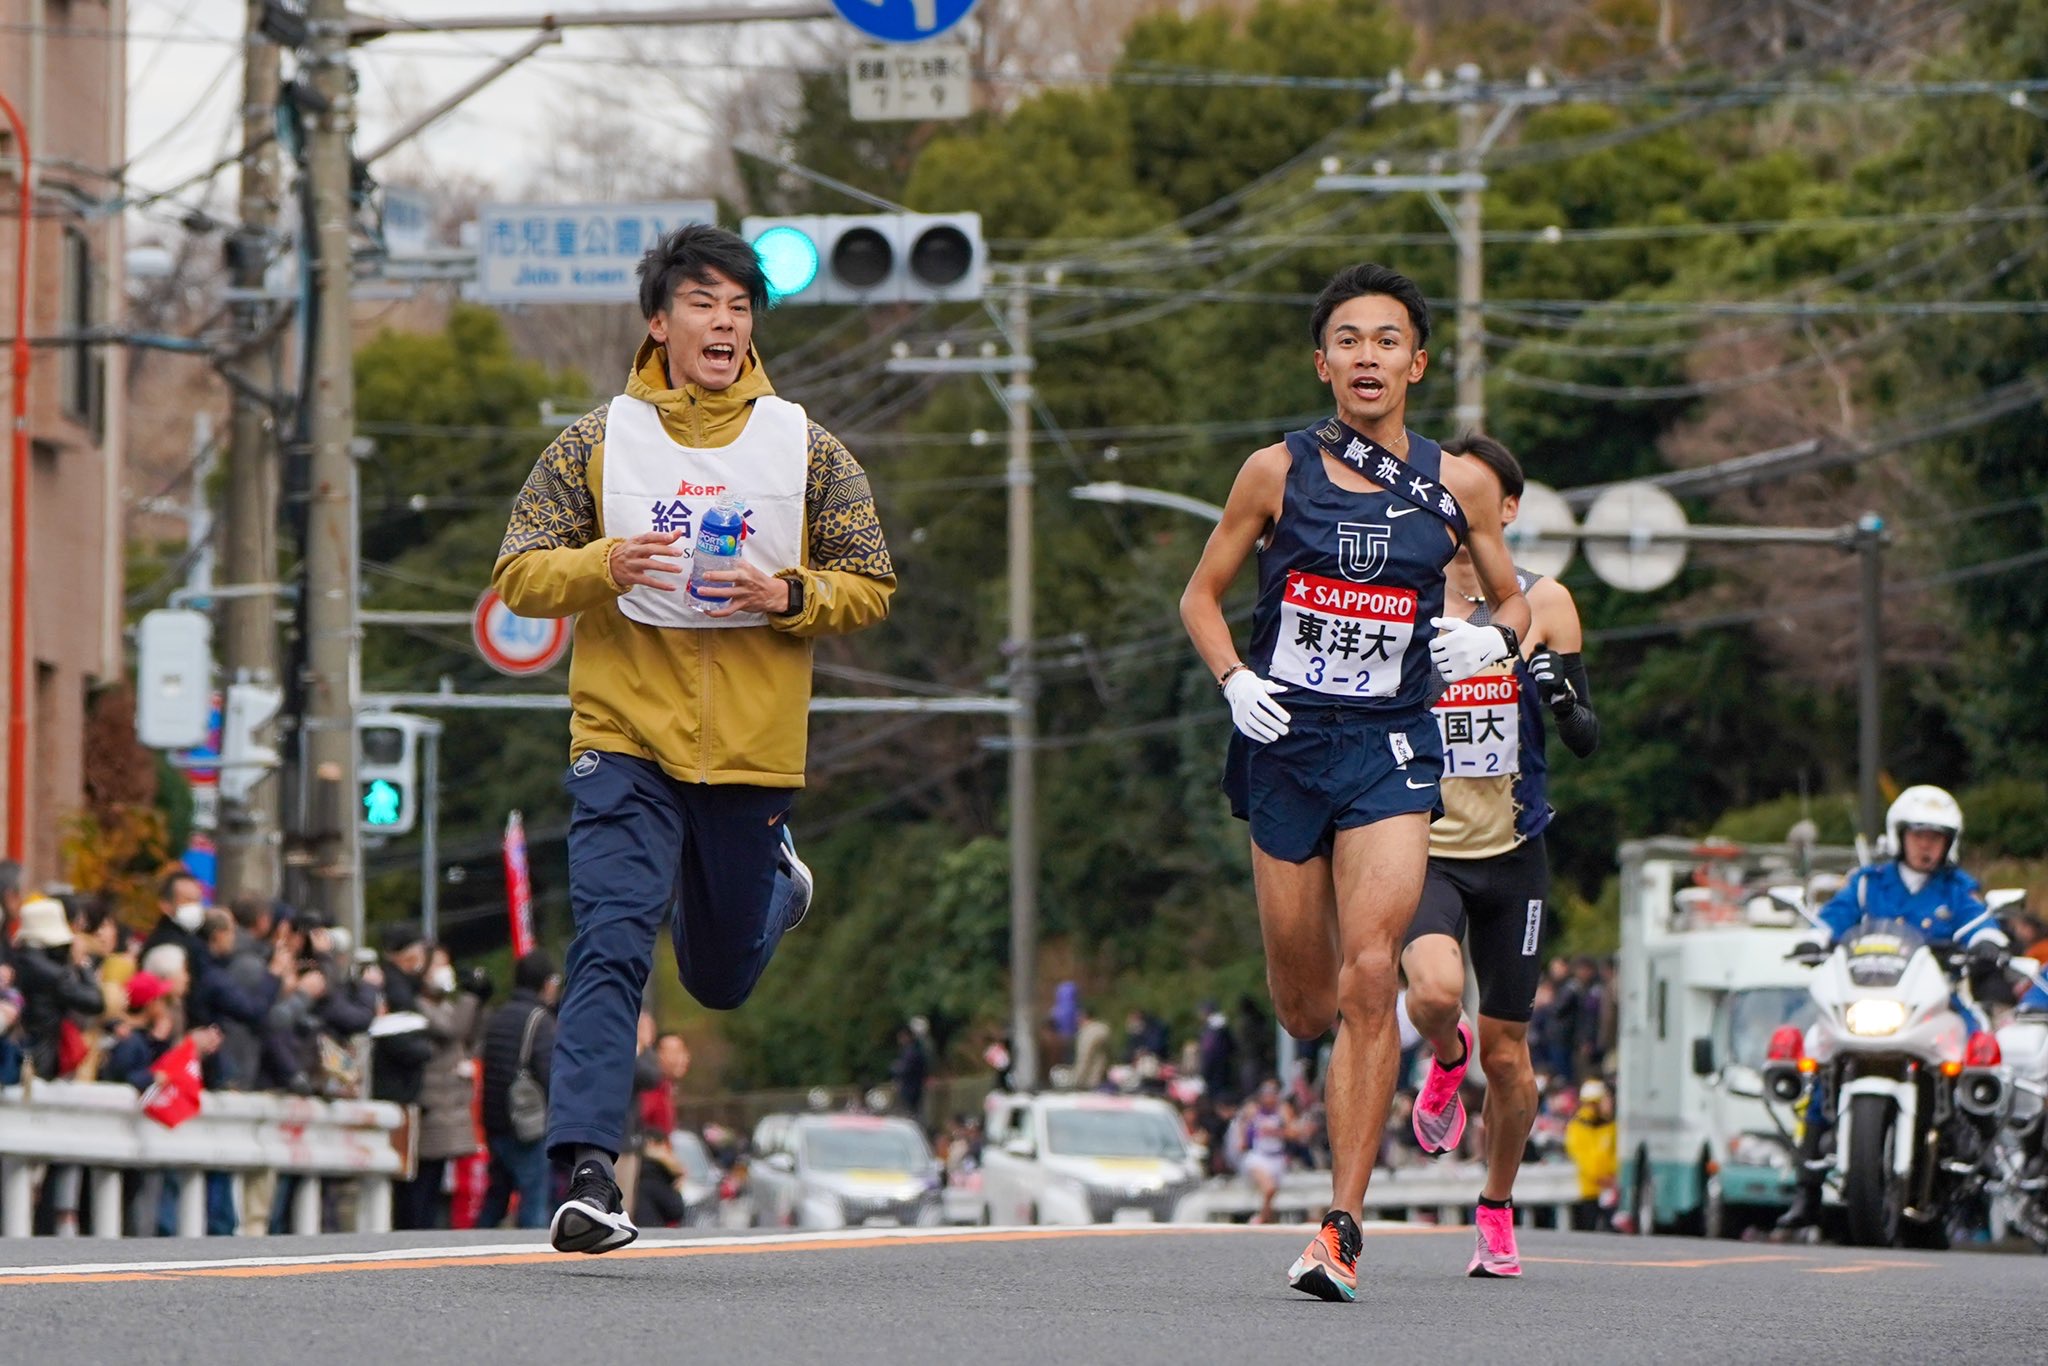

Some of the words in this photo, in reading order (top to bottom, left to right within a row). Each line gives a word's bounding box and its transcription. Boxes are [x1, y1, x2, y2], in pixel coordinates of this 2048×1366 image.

[1343, 436, 1457, 517] 東洋大学
[1313, 585, 1412, 617] SAPPORO
[1294, 611, 1397, 662] 東洋大
[1305, 656, 1371, 693] 3-2
[1435, 709, 1505, 746] 国大
[1443, 748, 1500, 774] 1-2
